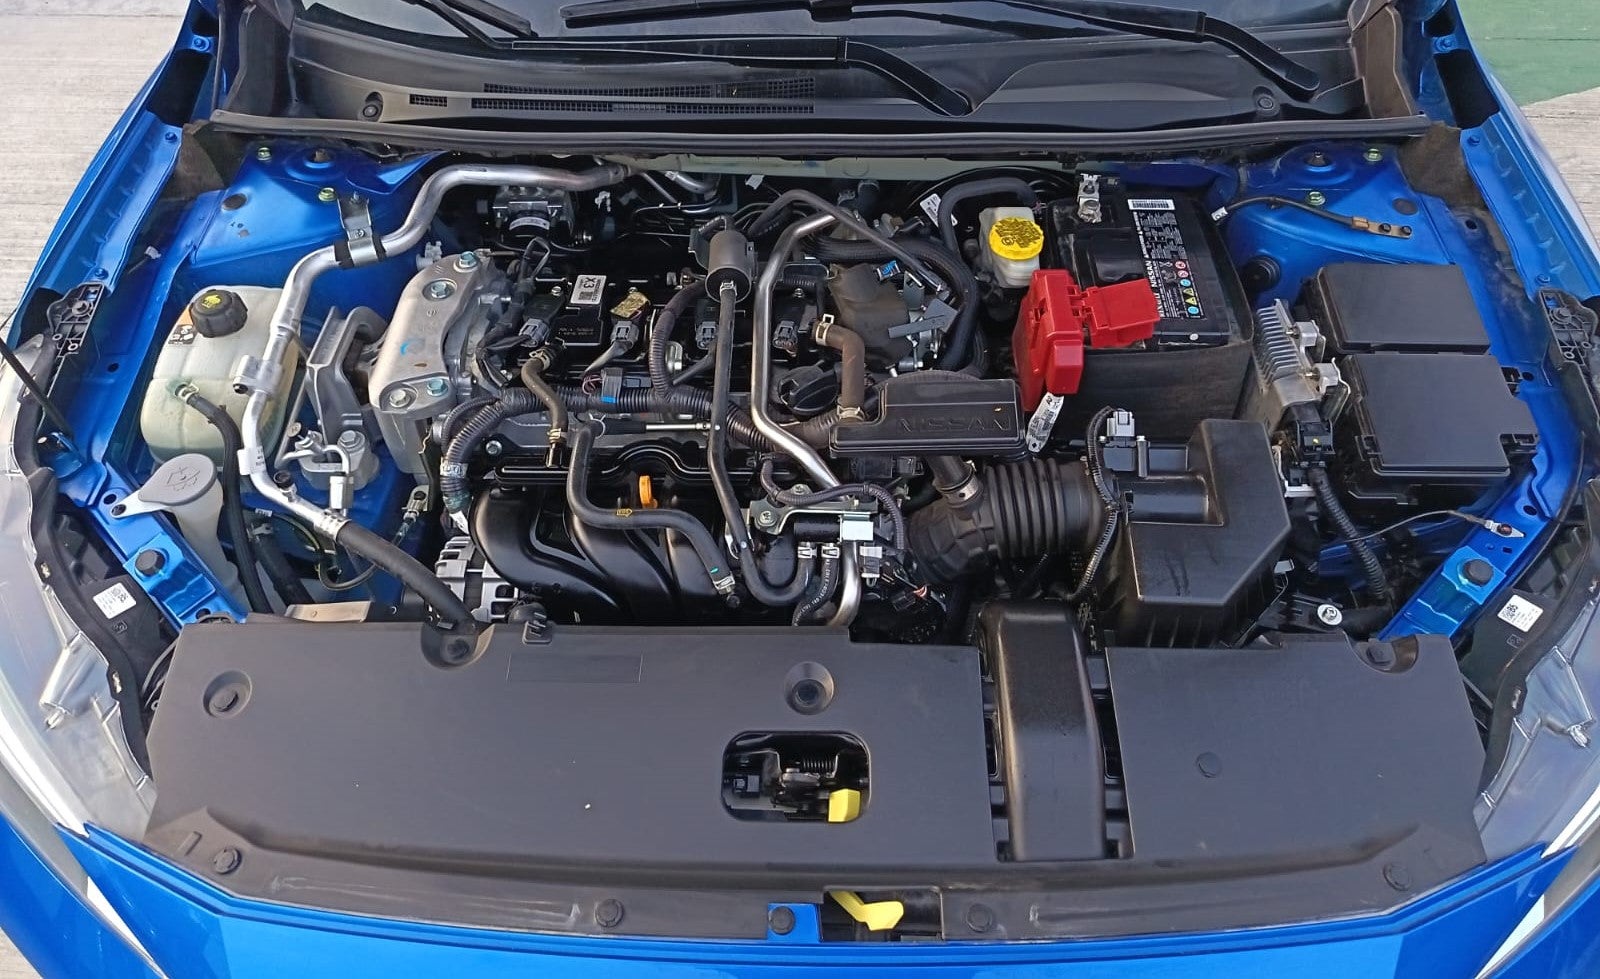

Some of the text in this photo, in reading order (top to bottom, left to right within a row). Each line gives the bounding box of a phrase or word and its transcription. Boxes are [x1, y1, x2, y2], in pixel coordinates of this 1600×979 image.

[1144, 260, 1158, 288] NISSAN
[583, 277, 596, 288] X3
[897, 416, 1012, 432] NISSAN
